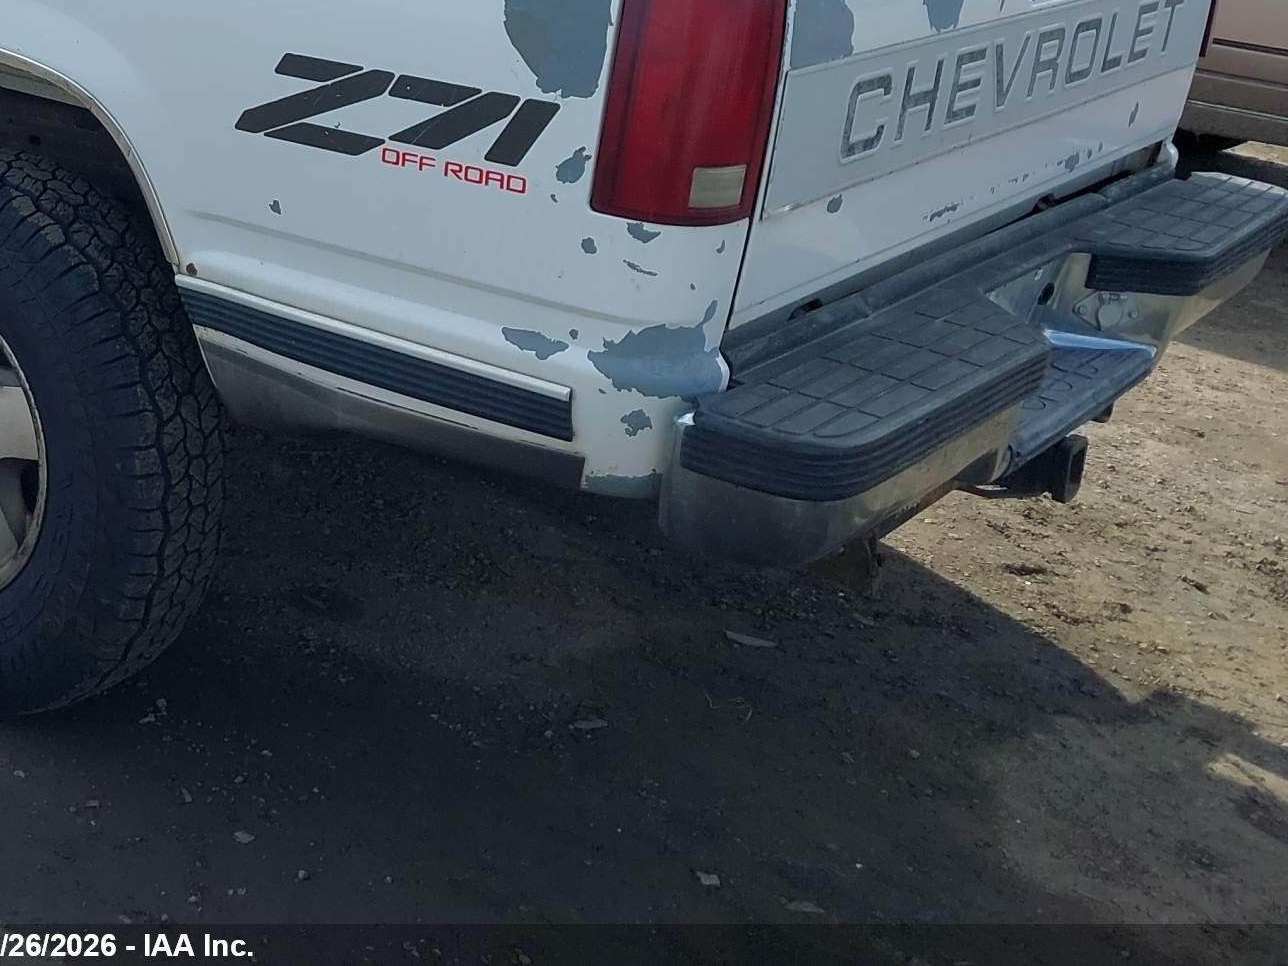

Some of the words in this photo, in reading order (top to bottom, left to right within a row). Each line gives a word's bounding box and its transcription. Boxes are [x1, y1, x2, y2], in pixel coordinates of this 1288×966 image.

[234, 52, 561, 167] Z71
[380, 146, 437, 172] OFF
[443, 160, 528, 195] ROAD
